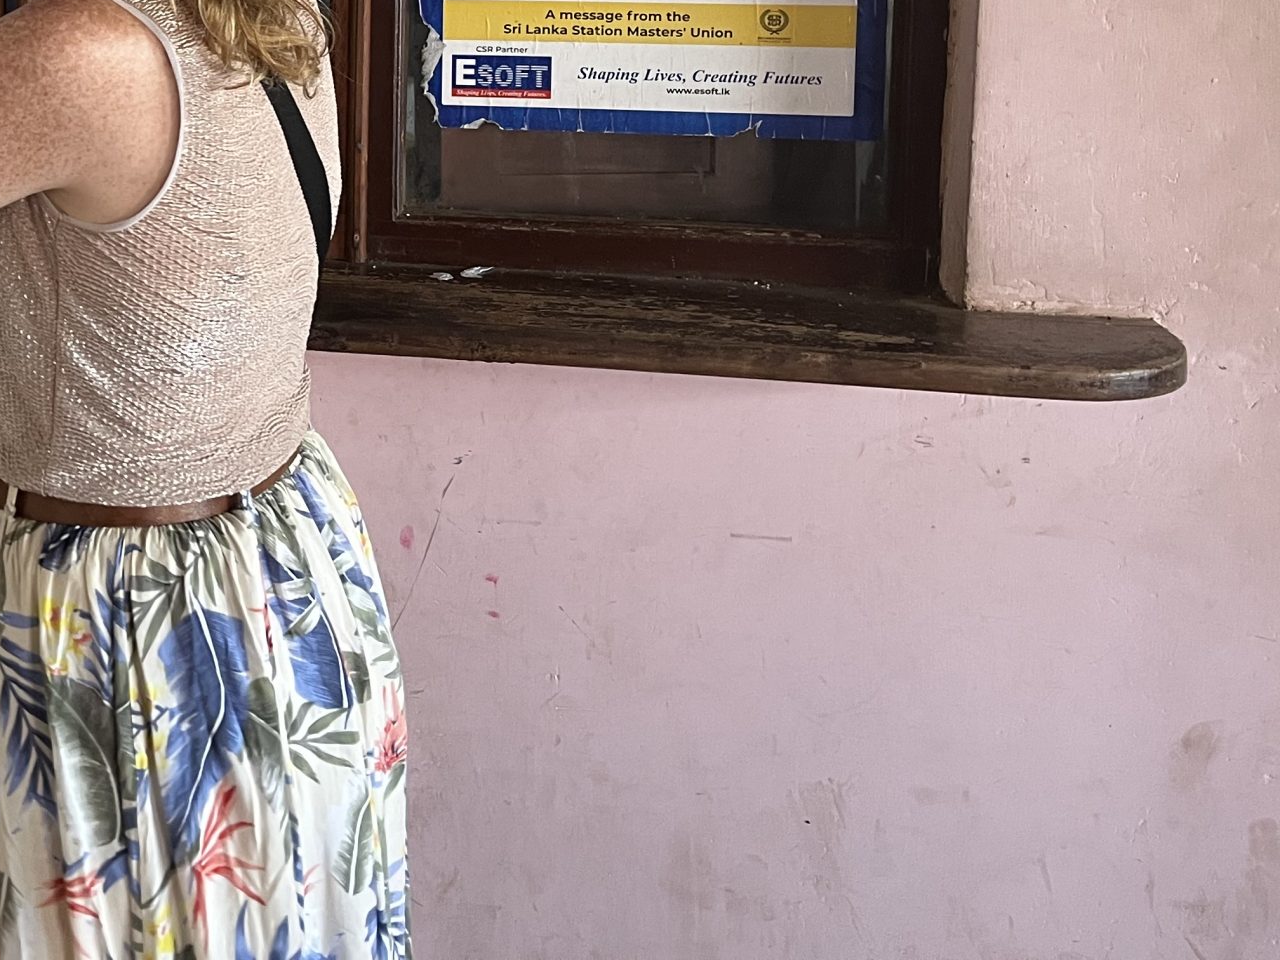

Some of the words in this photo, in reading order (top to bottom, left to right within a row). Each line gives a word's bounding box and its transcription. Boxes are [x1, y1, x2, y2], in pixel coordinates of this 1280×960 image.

[545, 10, 555, 20] A
[559, 12, 623, 23] message
[626, 10, 662, 21] from
[666, 11, 690, 22] the
[503, 23, 521, 34] Sri
[525, 24, 567, 35] Lanka
[571, 24, 622, 36] Station
[627, 26, 686, 37] Masters'
[690, 26, 732, 38] Union
[476, 45, 494, 53] CSR
[496, 46, 529, 54] Partner
[455, 58, 549, 88] ESOFT
[577, 66, 639, 84] Shaping
[643, 68, 685, 83] Lives,
[692, 69, 757, 86] Creating
[762, 71, 822, 85] Futures
[666, 87, 730, 95] www.esoft.lk
